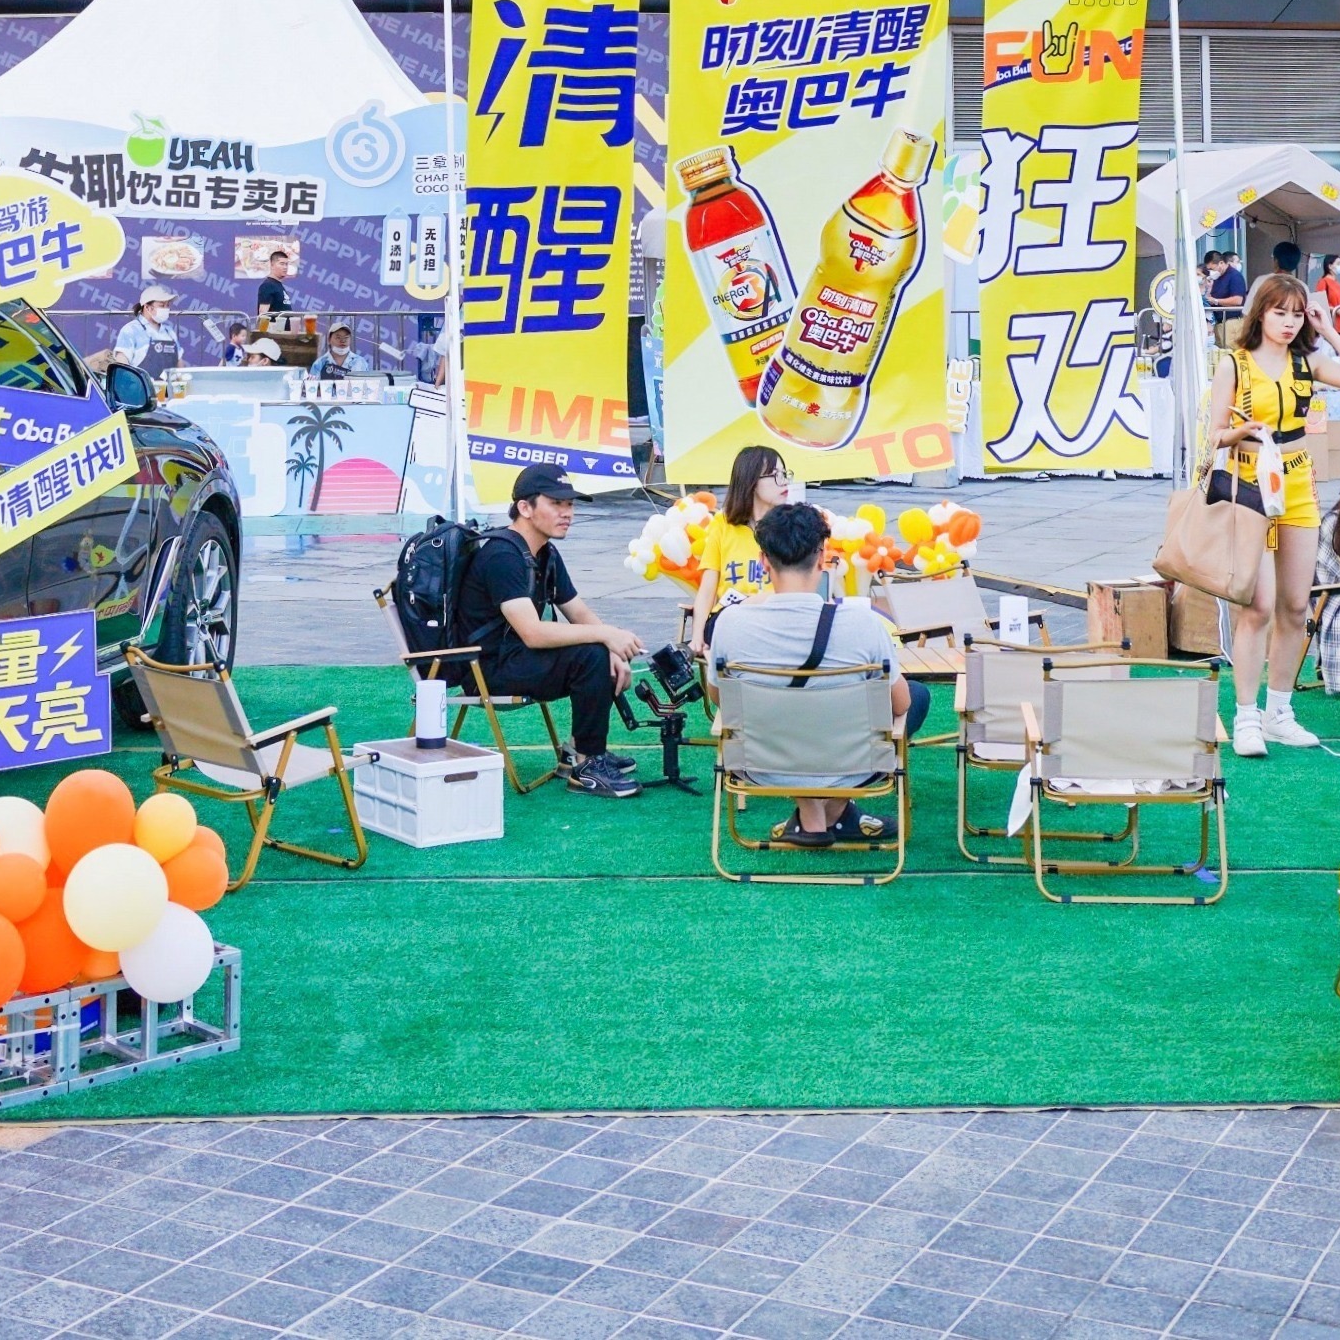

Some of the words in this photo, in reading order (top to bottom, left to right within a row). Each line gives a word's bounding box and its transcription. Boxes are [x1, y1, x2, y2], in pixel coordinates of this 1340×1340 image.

[700, 3, 930, 73] 时刻清醒
[722, 62, 911, 135] 奥巴牛
[168, 137, 255, 173] YEAH
[463, 0, 640, 336] 清醒
[388, 231, 402, 272] 0添加
[424, 228, 437, 272] 无负担
[712, 284, 750, 306] ENERGY
[819, 287, 877, 316] 时刻清醒
[979, 123, 1150, 464] 狂欢
[804, 309, 839, 331] Oba
[839, 317, 873, 338] Bull
[807, 324, 857, 352] 奥巴牛
[466, 381, 631, 447] TIME
[948, 361, 971, 433] NICE
[503, 446, 569, 467] SOBER
[855, 422, 953, 476] TO
